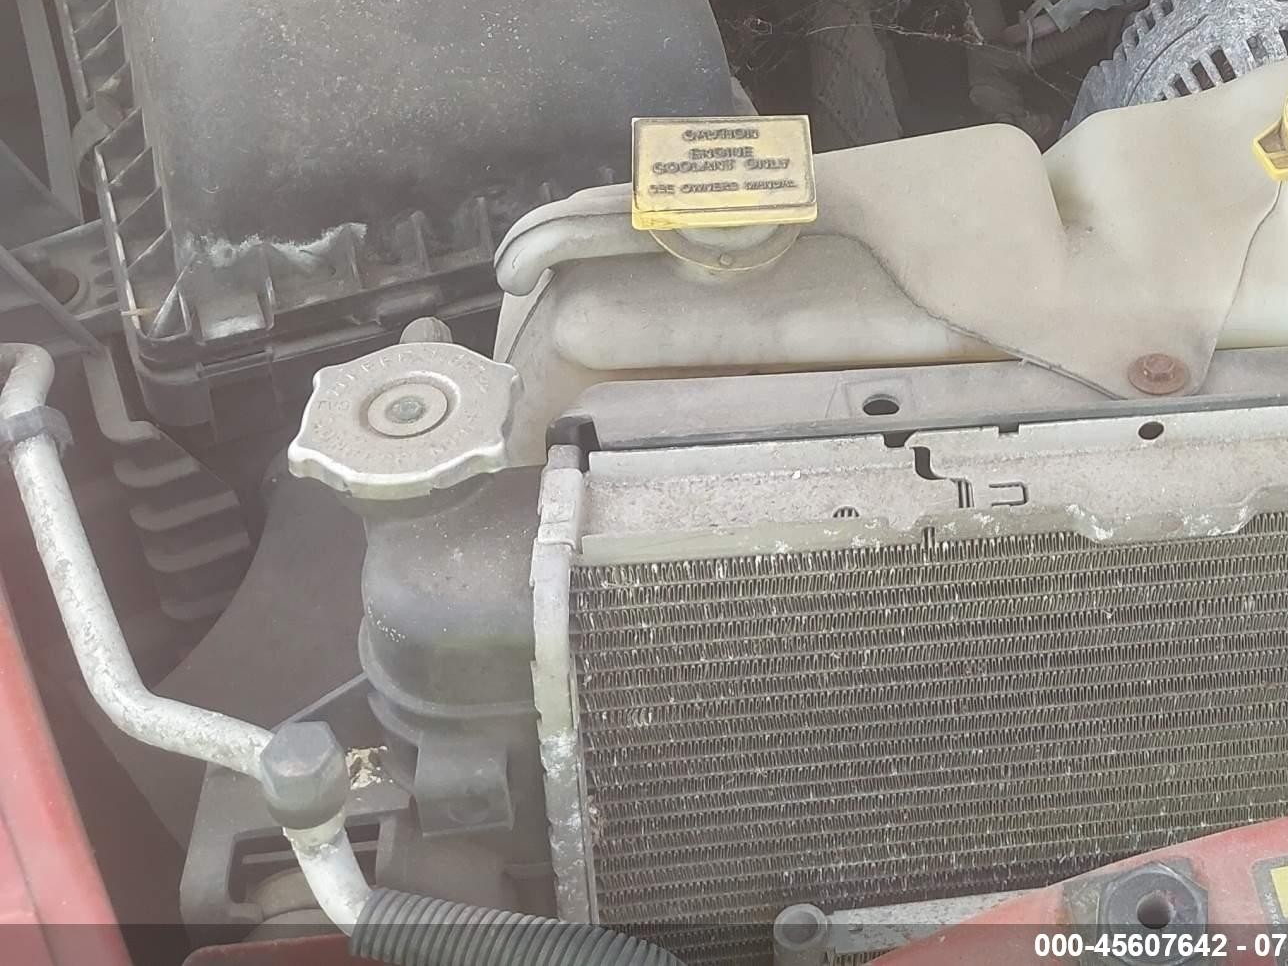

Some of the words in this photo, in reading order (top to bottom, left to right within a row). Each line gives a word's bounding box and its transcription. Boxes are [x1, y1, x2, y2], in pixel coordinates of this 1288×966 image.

[682, 128, 760, 142] CAUTION
[688, 146, 754, 160] ENGINE
[652, 159, 735, 175] COOLANT
[744, 158, 790, 172] ONLY
[648, 183, 675, 195] SEE
